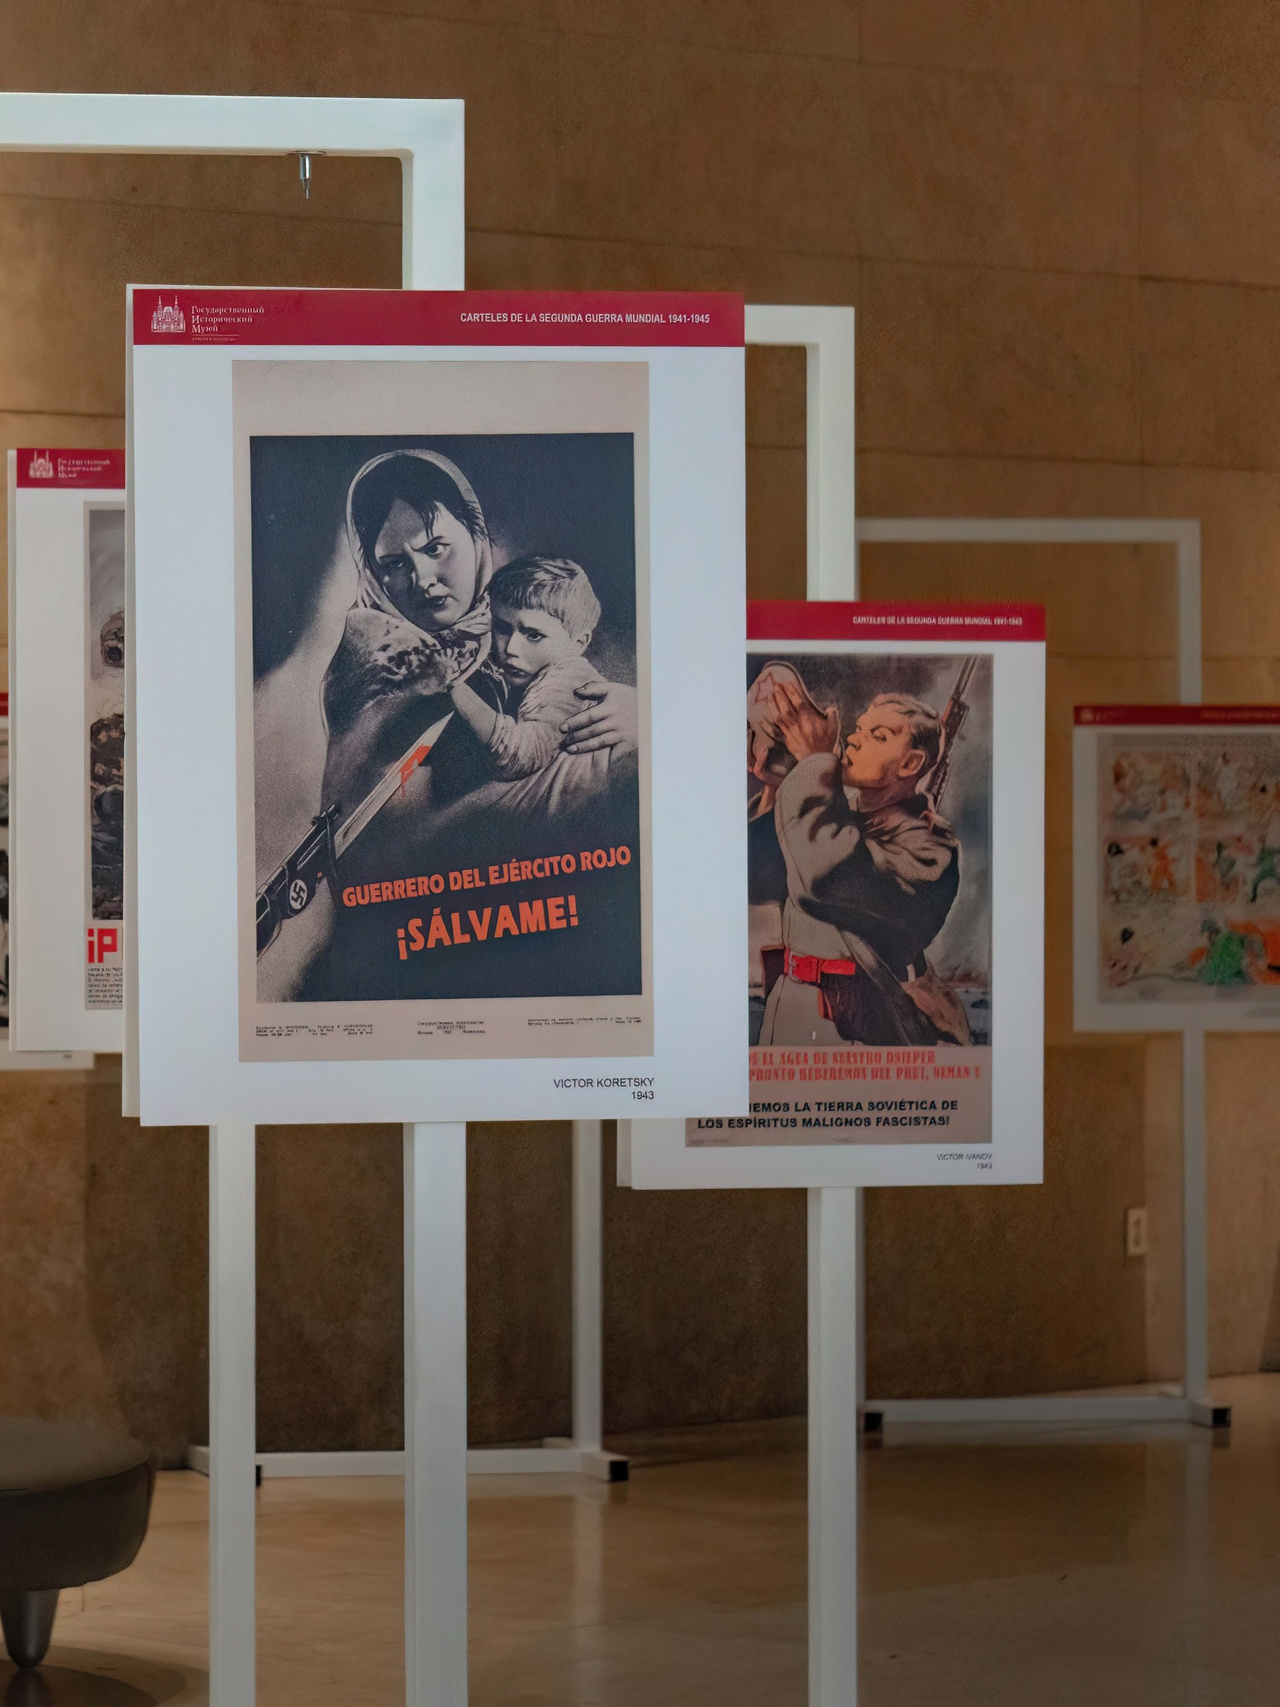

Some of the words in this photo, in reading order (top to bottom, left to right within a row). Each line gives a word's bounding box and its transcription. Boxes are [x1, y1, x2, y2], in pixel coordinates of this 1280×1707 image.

[191, 306, 264, 314] Государственный
[191, 315, 253, 323] Исторический
[460, 313, 508, 322] CARTELES
[510, 313, 523, 322] DE
[525, 313, 538, 322] LA
[539, 313, 583, 323] SEGUNDA
[585, 313, 623, 323] GUERRA
[625, 314, 666, 323] MUNDIAL
[668, 314, 710, 323] 1941-1945
[191, 324, 218, 333] Музей
[342, 873, 445, 907] GUERRERO
[448, 868, 486, 891] DEL
[488, 853, 576, 884] EJÉRCITO
[580, 845, 631, 871] ROJO
[397, 895, 579, 960] ¡SÁLVAME!
[779, 1051, 809, 1066] AGUA
[553, 1078, 594, 1088] VICTOR
[596, 1077, 655, 1087] KORETSKY
[631, 1091, 655, 1100] 1943
[794, 1101, 811, 1112] LA
[815, 1101, 863, 1112] TIERRA
[867, 1099, 937, 1111] SOVIÉTICA
[941, 1100, 958, 1111] DE
[698, 1118, 724, 1129] LOS
[728, 1115, 798, 1129] ESPÍRITUS
[801, 1116, 871, 1128] MALIGNOS
